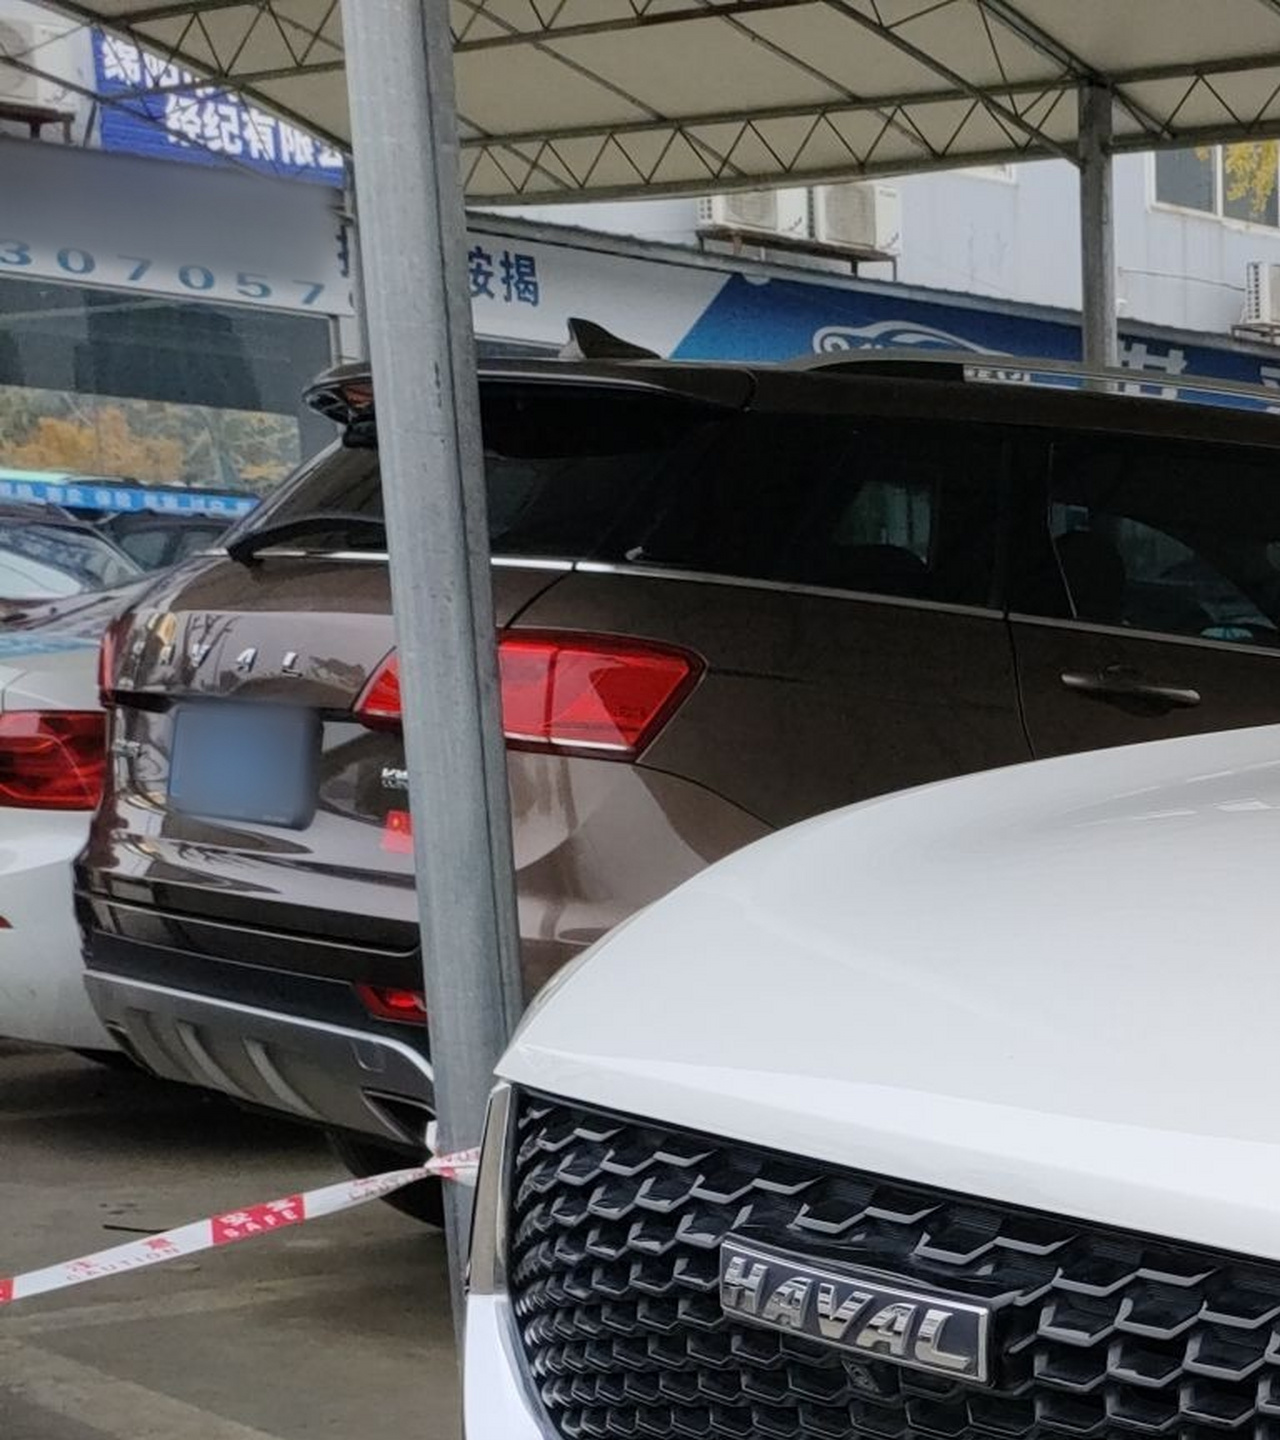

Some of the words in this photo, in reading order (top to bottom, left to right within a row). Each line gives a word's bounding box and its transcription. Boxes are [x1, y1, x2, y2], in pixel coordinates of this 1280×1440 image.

[222, 1208, 300, 1240] SAFE
[66, 1246, 181, 1283] CAUTION
[721, 1254, 971, 1371] HAVAL
